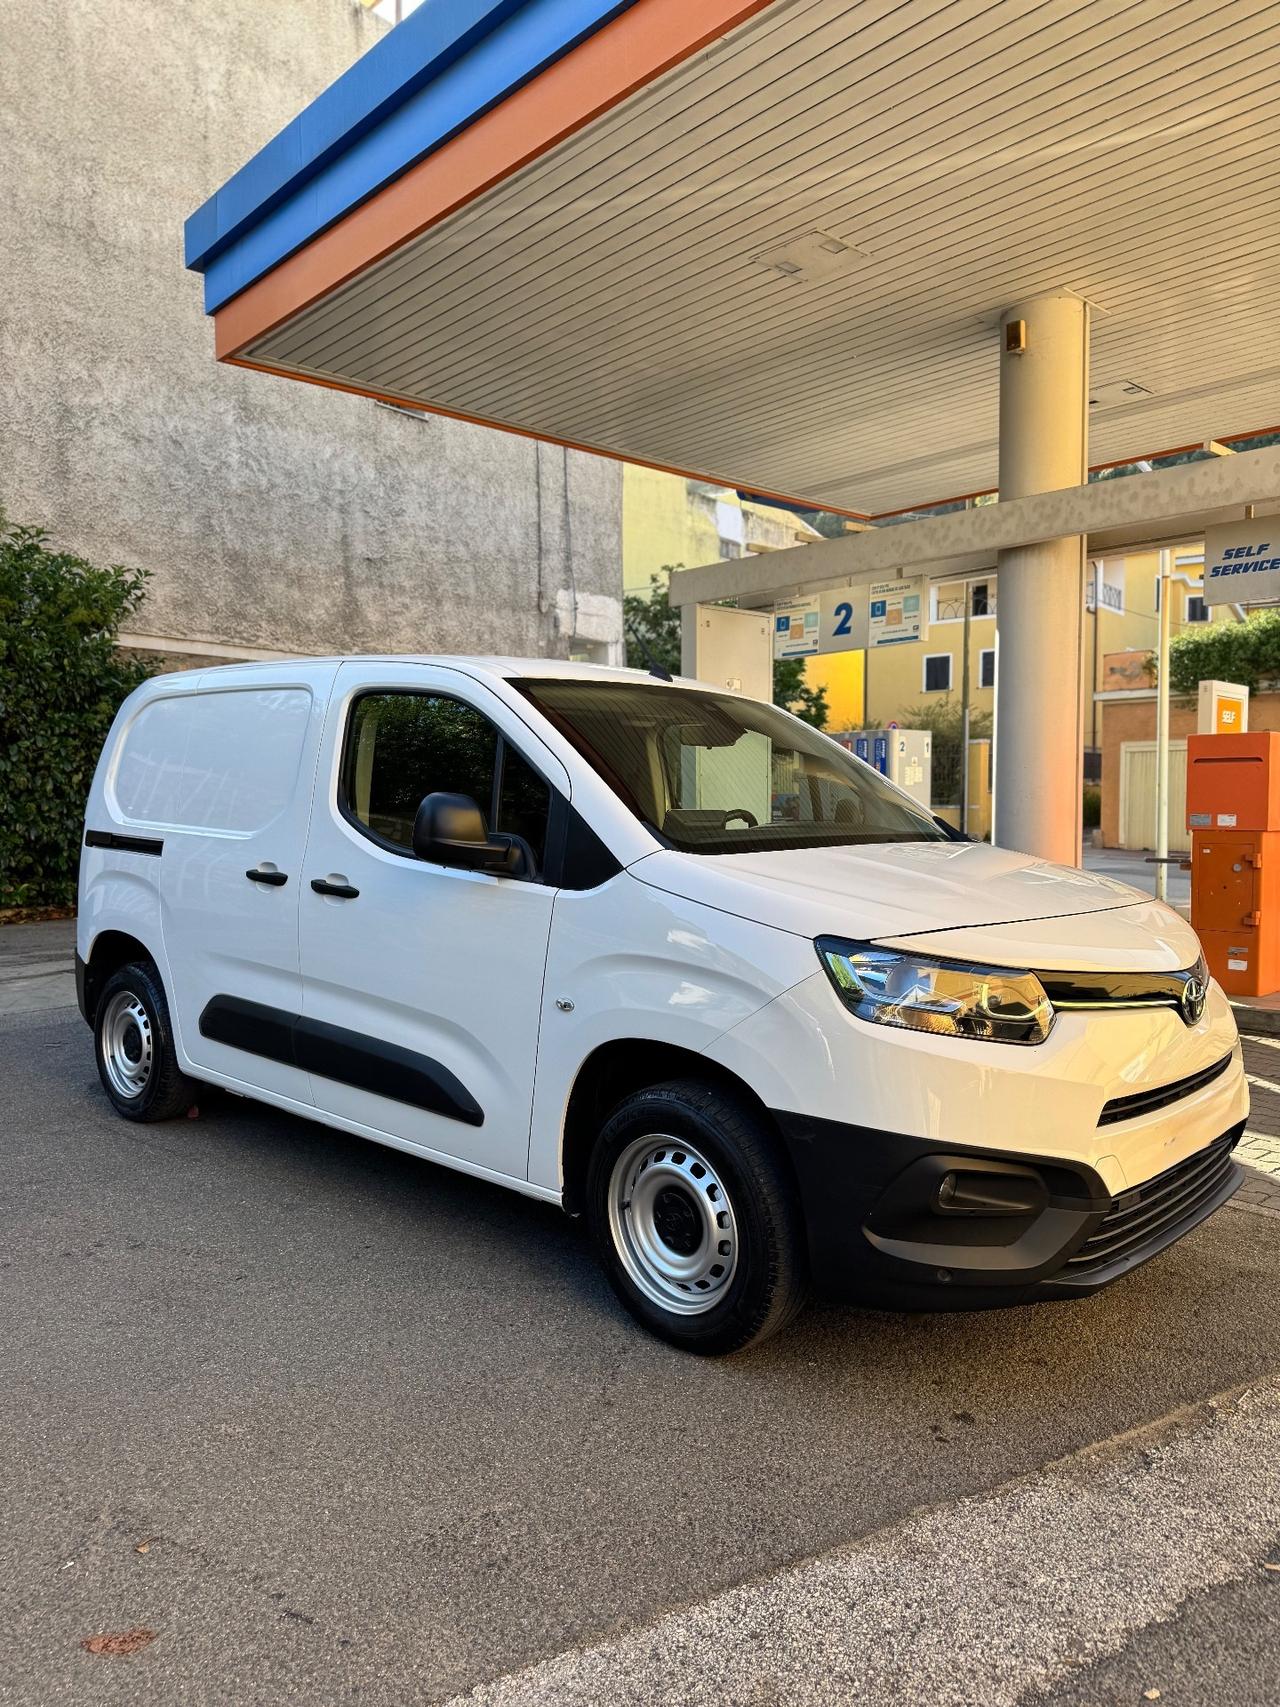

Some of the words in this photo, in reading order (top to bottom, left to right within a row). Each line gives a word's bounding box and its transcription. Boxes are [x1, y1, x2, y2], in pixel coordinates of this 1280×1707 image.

[1222, 543, 1270, 560] SELF
[1209, 558, 1280, 577] SERVICE
[832, 602, 853, 636] 2
[1222, 710, 1236, 722] SELF
[899, 741, 905, 752] 2
[925, 742, 930, 752] 1
